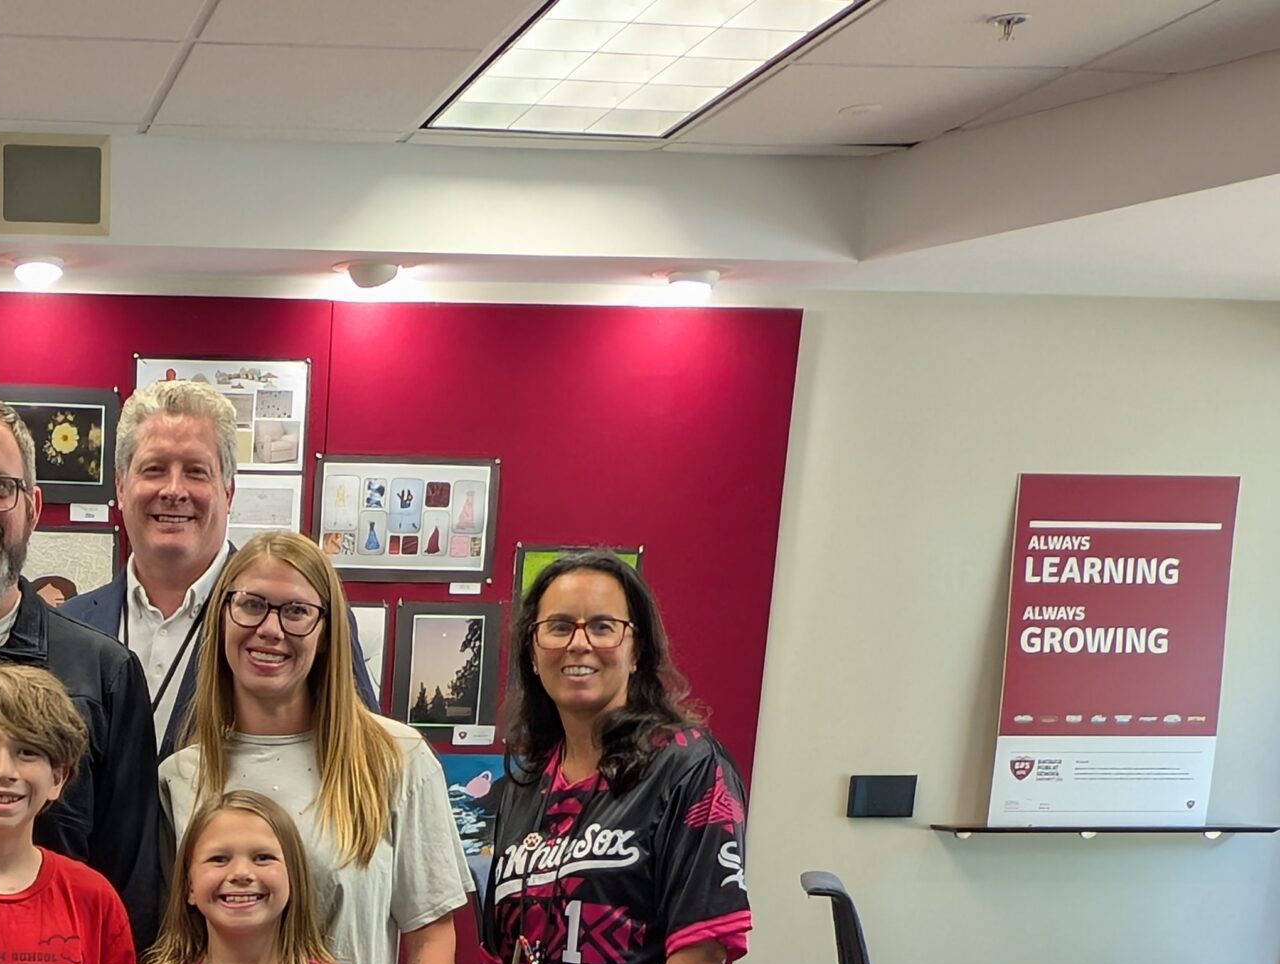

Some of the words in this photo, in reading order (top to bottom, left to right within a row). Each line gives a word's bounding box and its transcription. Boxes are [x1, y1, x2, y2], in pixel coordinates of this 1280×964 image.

[1028, 535, 1091, 551] ALWAYS
[1024, 556, 1180, 585] LEARNING
[1022, 606, 1086, 621] ALWAYS
[1020, 626, 1169, 654] GROWING
[572, 823, 639, 861] Sox
[562, 900, 582, 964] 1
